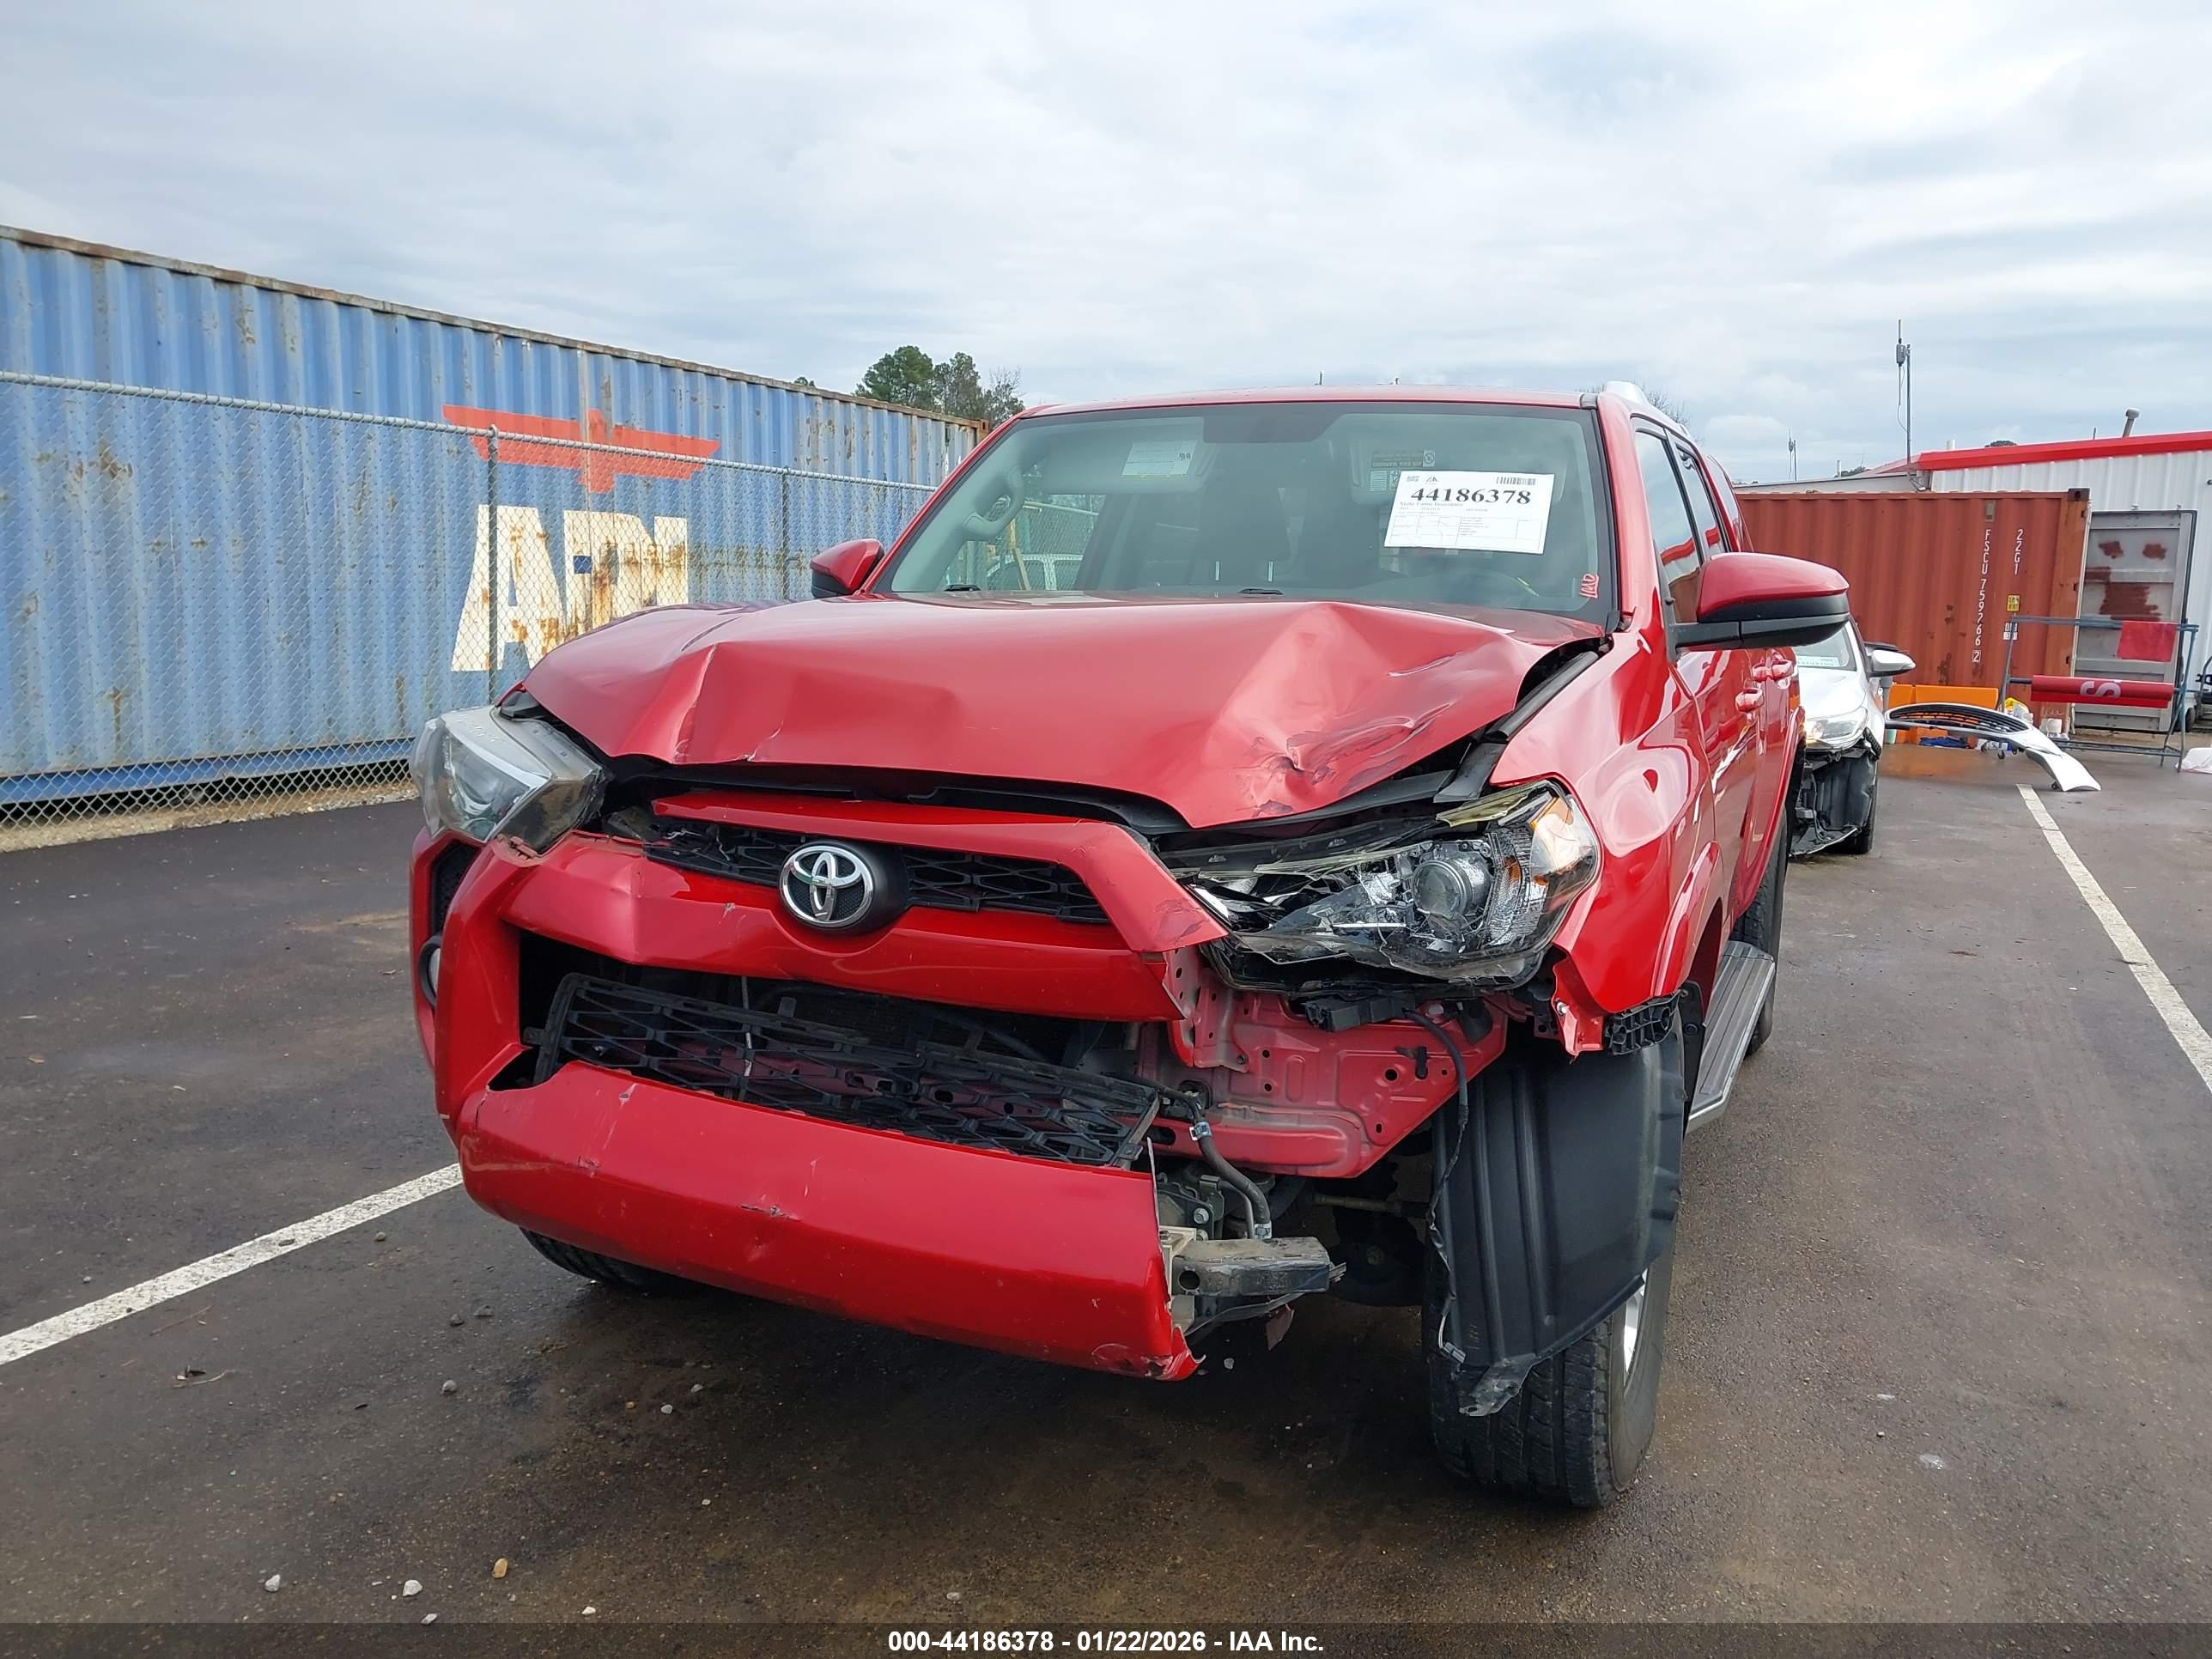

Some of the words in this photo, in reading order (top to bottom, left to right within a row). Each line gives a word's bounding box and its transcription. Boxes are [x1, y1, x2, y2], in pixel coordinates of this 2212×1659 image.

[1410, 488, 1532, 505] 44186378
[1981, 529, 1991, 574] FSCU
[2014, 529, 2024, 575] 22G1
